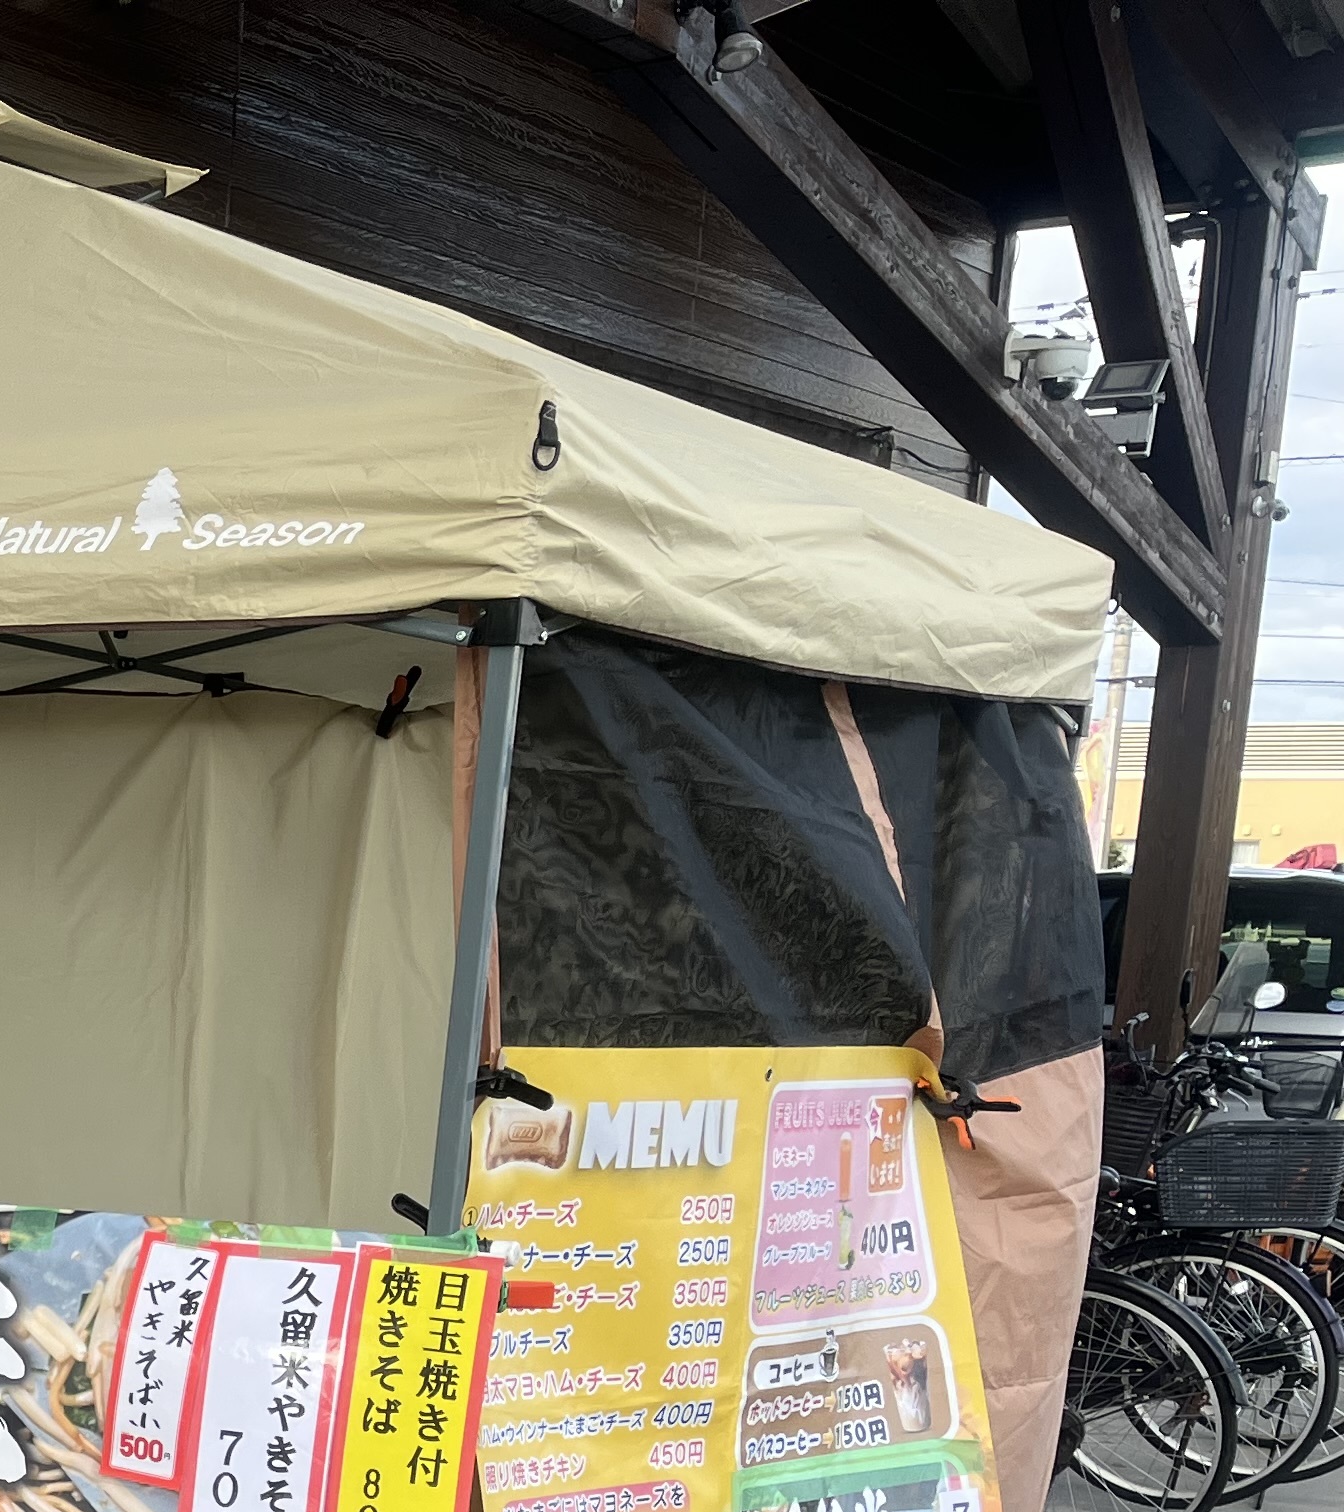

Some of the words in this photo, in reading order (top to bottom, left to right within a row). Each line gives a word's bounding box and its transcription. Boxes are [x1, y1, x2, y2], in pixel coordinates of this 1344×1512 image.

[182, 513, 365, 550] Season
[773, 1146, 814, 1168] レモネード
[772, 1177, 835, 1200] マンゴーネクター
[682, 1197, 733, 1222] 250円
[679, 1239, 729, 1264] 250円
[861, 1220, 914, 1255] 400円
[165, 1256, 210, 1347] 久留米
[674, 1280, 727, 1306] 350円
[669, 1321, 722, 1347] 350円
[363, 1265, 420, 1435] 焼きそば
[407, 1272, 468, 1487] 目玉焼き付
[663, 1361, 717, 1389] 400円
[769, 1357, 814, 1385] コーヒー
[654, 1402, 712, 1427] 400円
[748, 1393, 824, 1424] ホットコーヒー
[837, 1381, 883, 1412] 150円
[746, 1429, 821, 1463] アイスコーヒー
[835, 1417, 889, 1449] 150円
[485, 1454, 585, 1490] 照り焼きチキン
[650, 1441, 704, 1467] 450円
